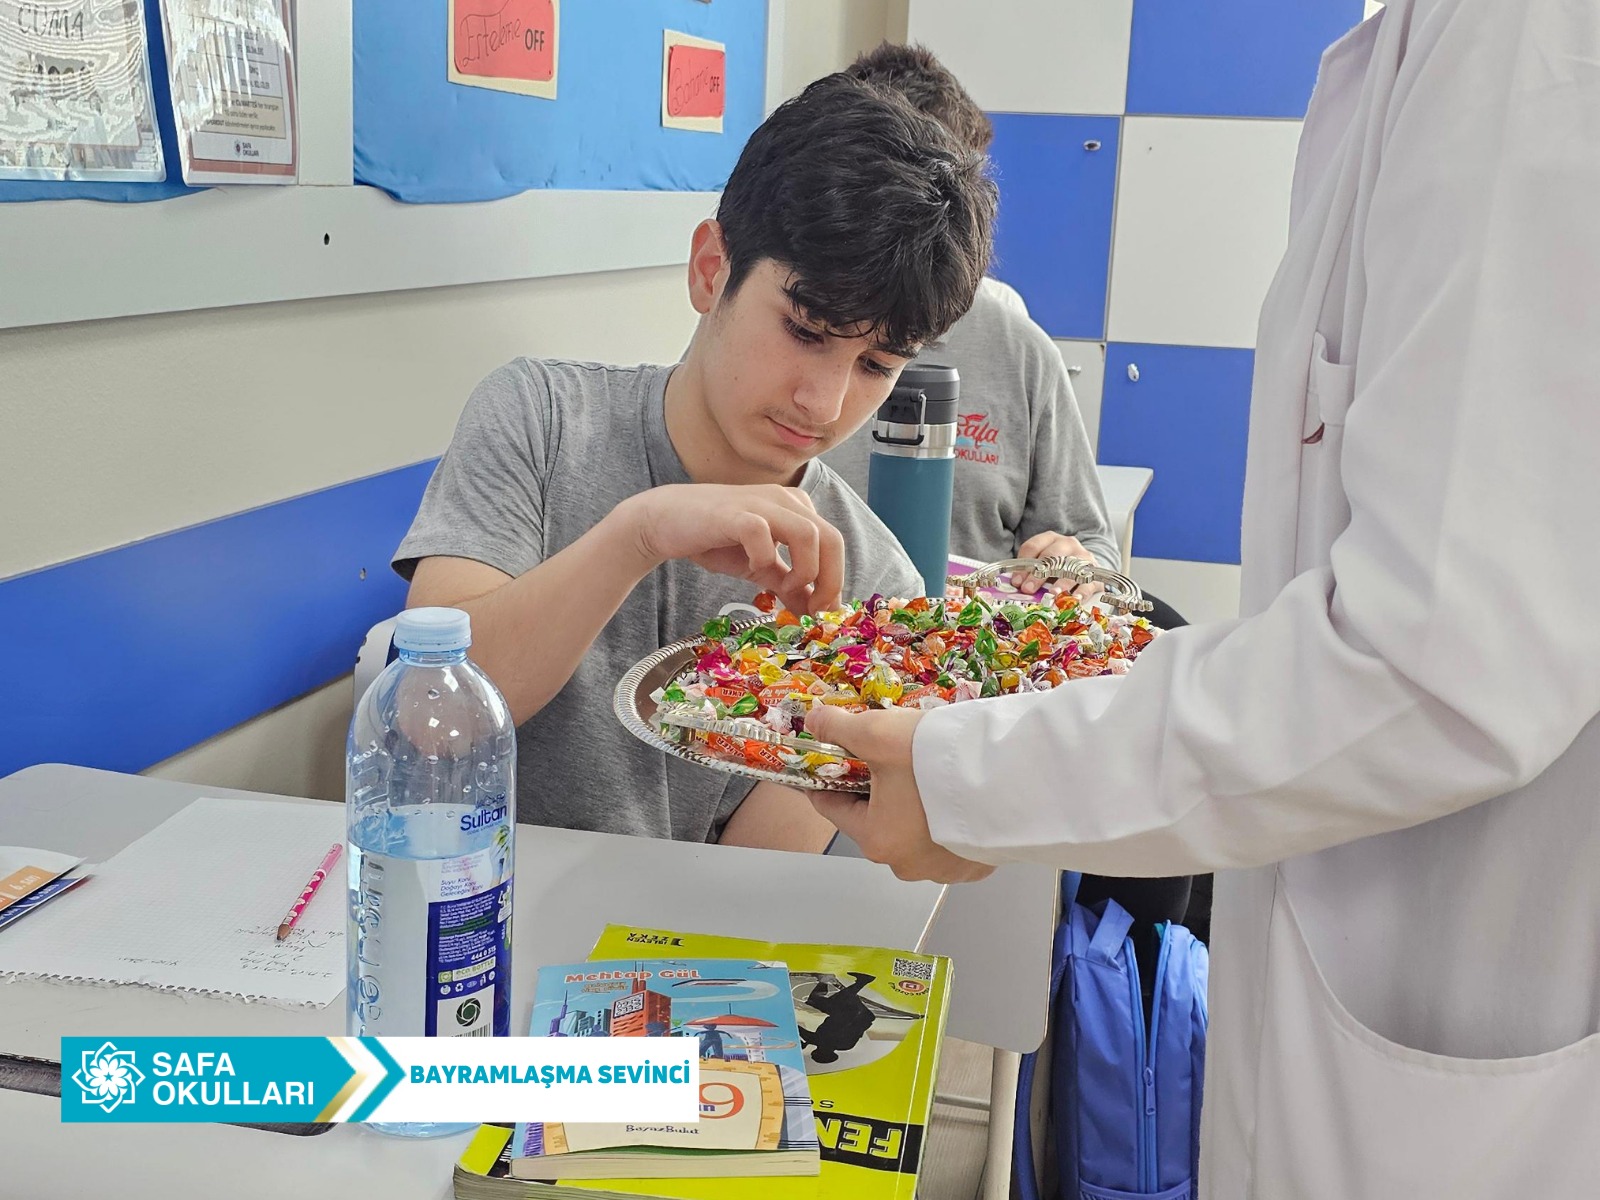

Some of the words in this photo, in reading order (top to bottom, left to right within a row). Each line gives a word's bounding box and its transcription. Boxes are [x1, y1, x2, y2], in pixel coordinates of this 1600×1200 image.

[524, 28, 545, 52] OFF
[460, 805, 507, 831] Sultan
[565, 969, 654, 984] Mehtap
[812, 1116, 903, 1160] FEN
